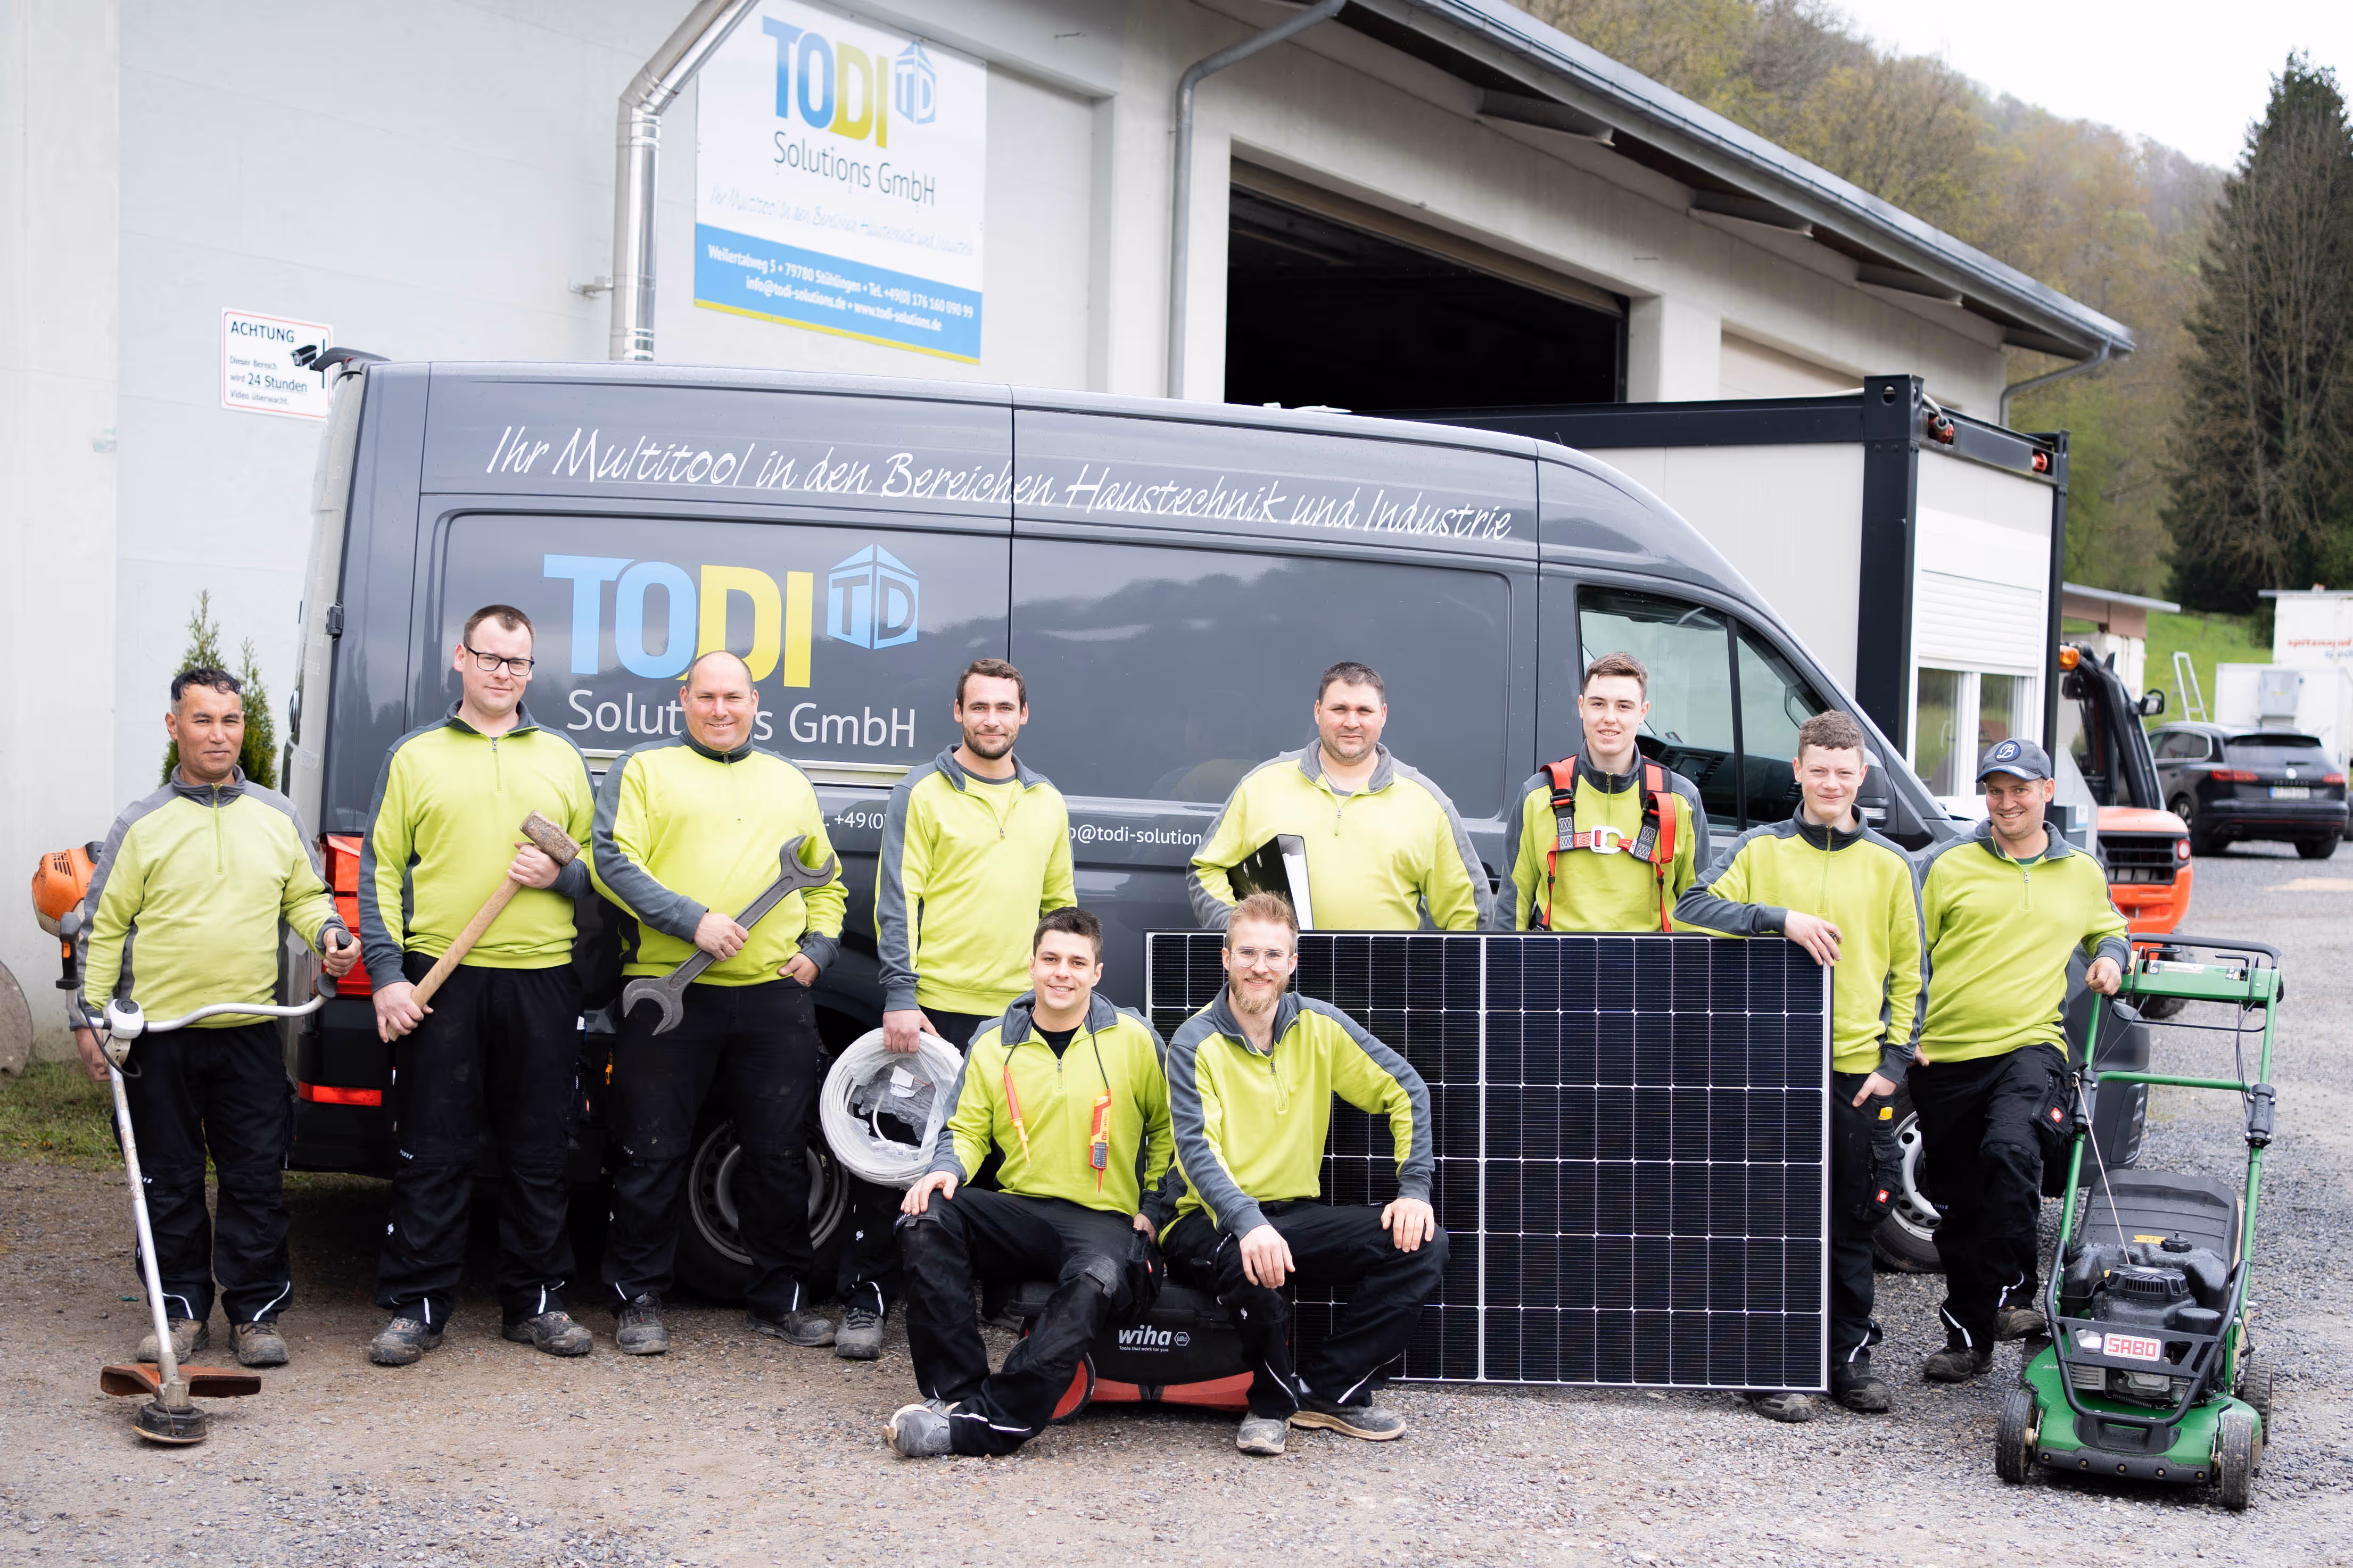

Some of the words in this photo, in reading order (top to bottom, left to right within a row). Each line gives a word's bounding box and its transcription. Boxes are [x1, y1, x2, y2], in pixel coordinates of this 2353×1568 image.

[763, 14, 888, 148] TODI
[774, 131, 871, 188] Solutions
[878, 162, 936, 206] GmbH
[708, 244, 768, 275] Weilertalweg
[770, 259, 776, 272] 5
[786, 262, 814, 281] 79780
[912, 294, 928, 309] 176
[963, 304, 973, 319] 99
[746, 275, 846, 311] info@todi-solutions.de
[231, 321, 295, 343] ACHTUNG
[248, 372, 260, 385] 24
[265, 376, 307, 393] Stunden
[486, 426, 549, 474] Ihr
[551, 428, 756, 486] Multitool
[755, 451, 798, 490] in
[804, 446, 873, 494] den
[880, 452, 1056, 507] Bereichen
[1065, 463, 1287, 524] Haustechnik
[1290, 486, 1360, 529] und
[1363, 489, 1512, 541] Industrie
[543, 553, 814, 688] TODI
[566, 689, 773, 740] Soluts
[789, 702, 915, 748] GmbH
[834, 811, 887, 829] +49(0
[1069, 824, 1202, 845] o@todi-solution
[1119, 1324, 1172, 1345] wiha
[2109, 1338, 2156, 1357] SABO
